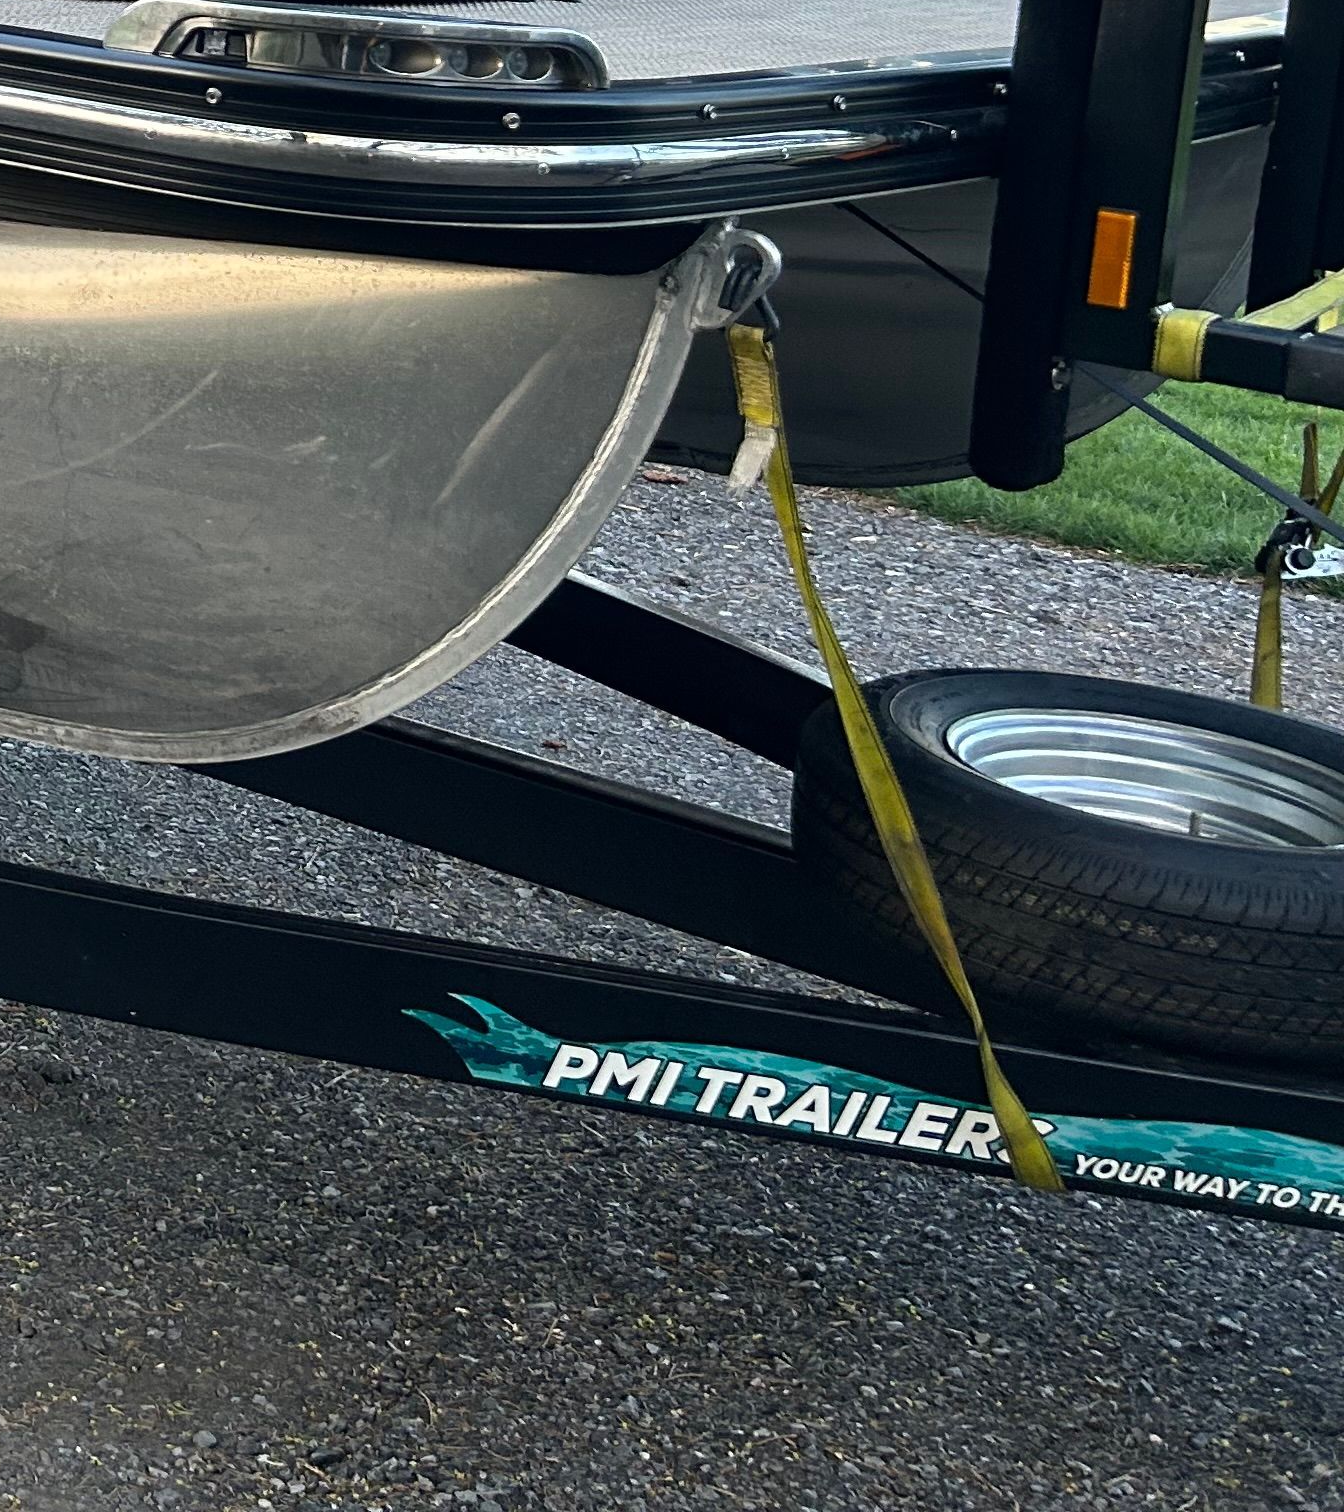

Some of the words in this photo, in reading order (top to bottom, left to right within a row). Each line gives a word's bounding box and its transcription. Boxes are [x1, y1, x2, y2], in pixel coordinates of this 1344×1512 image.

[542, 1044, 684, 1106] PMI
[1076, 1154, 1166, 1188] YOUR
[1173, 1170, 1251, 1200] WAY
[1256, 1183, 1301, 1209] TO
